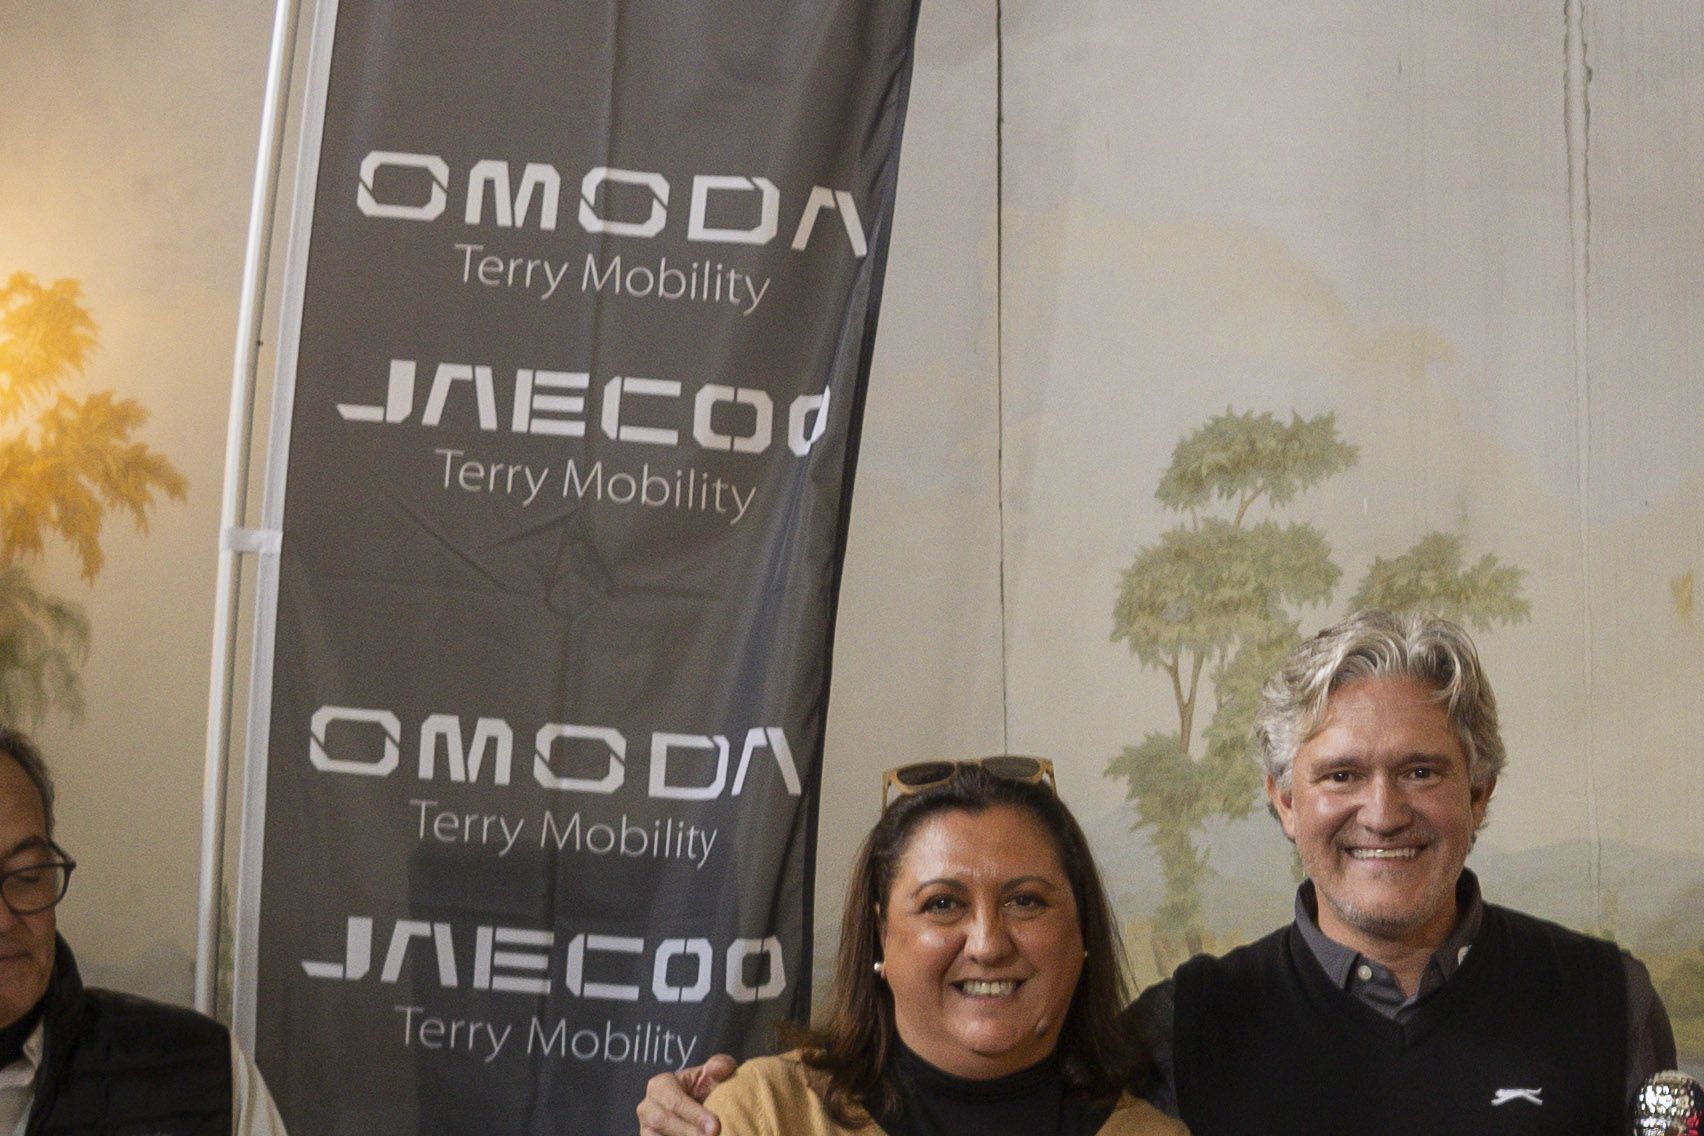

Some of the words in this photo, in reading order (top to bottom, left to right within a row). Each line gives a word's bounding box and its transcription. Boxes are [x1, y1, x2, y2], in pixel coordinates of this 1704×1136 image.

[356, 150, 868, 257] OMODA
[454, 244, 568, 300] Terry
[582, 252, 771, 315] Mobility
[434, 448, 549, 506] Terry
[562, 458, 757, 525] Mobility
[310, 705, 802, 800] OMODA
[408, 800, 526, 857] Terry
[540, 810, 718, 869] Mobility
[301, 916, 787, 1003] JAECOO
[394, 1006, 512, 1063] Terry
[527, 1017, 698, 1072] Mobility
